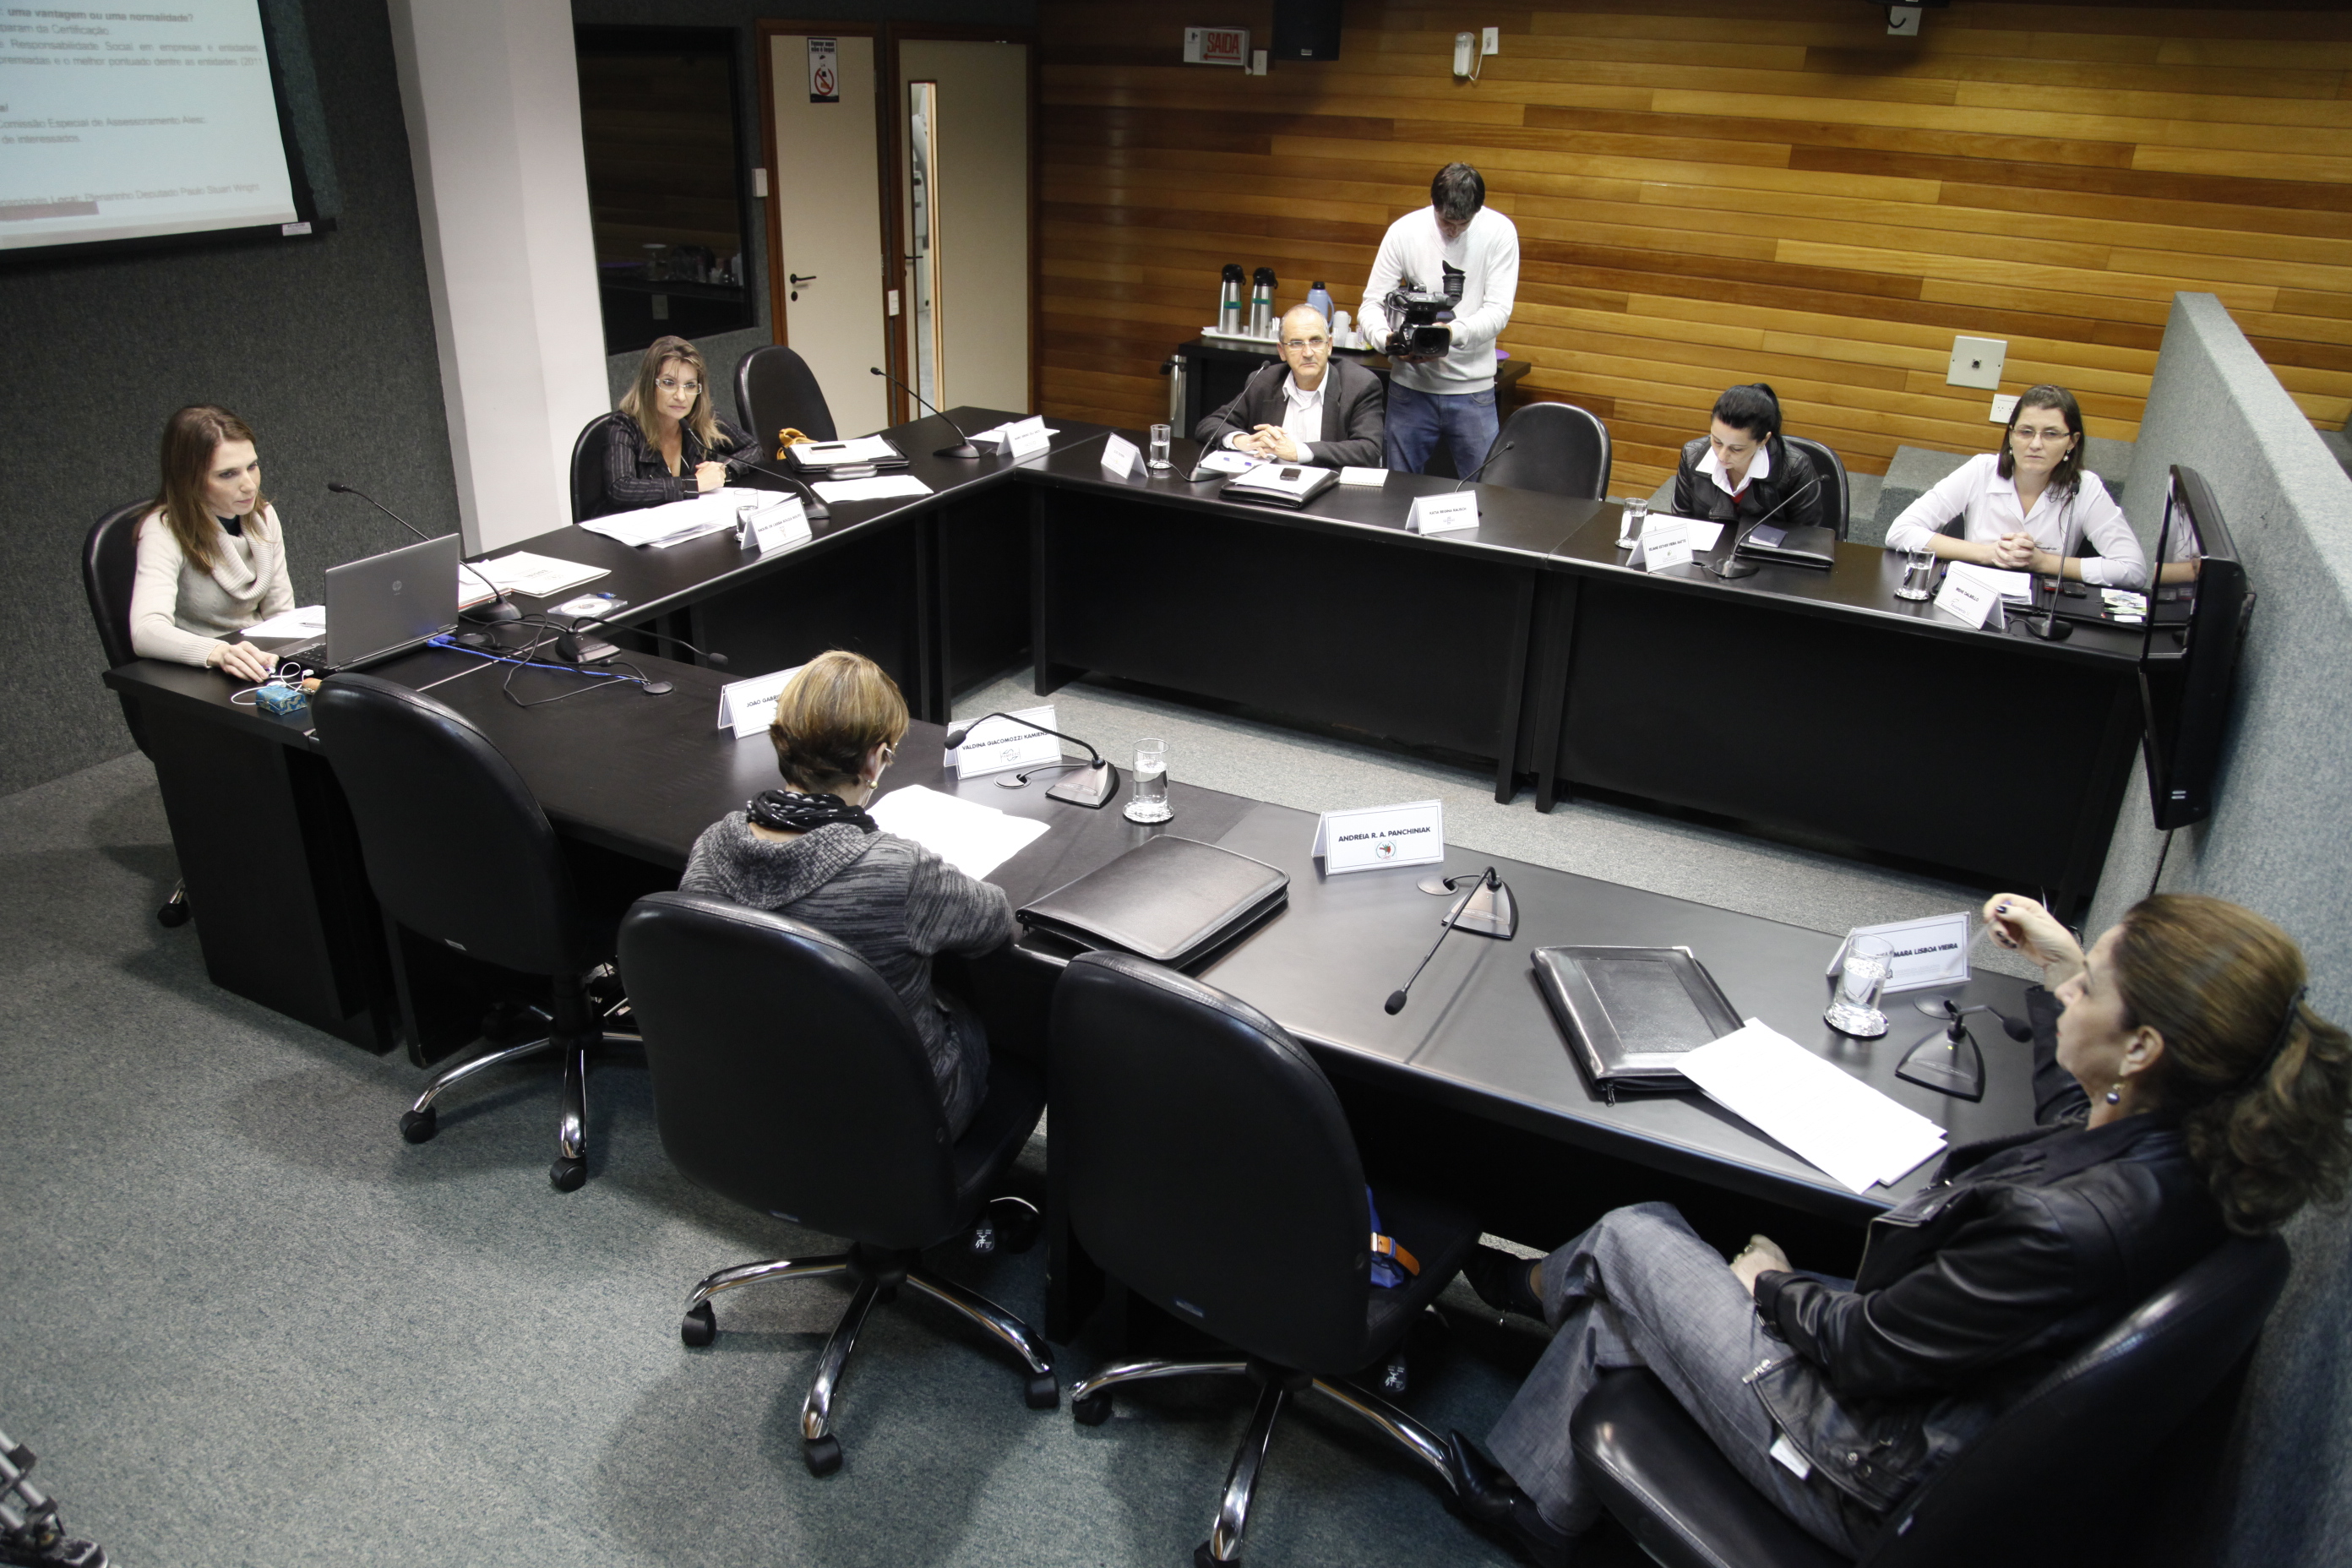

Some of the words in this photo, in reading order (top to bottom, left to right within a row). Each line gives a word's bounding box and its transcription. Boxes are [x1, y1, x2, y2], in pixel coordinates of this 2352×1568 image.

[35, 10, 86, 21] vantagem
[129, 13, 193, 22] normalidade?
[10, 39, 99, 51] Responsabilidade
[962, 742, 986, 750] VALDINA
[987, 735, 1023, 746] GIACOMOZZI
[1388, 826, 1431, 836] PANCHINIAK
[1914, 946, 1937, 955] LISBOA
[1938, 943, 1958, 951] VIEIRA
